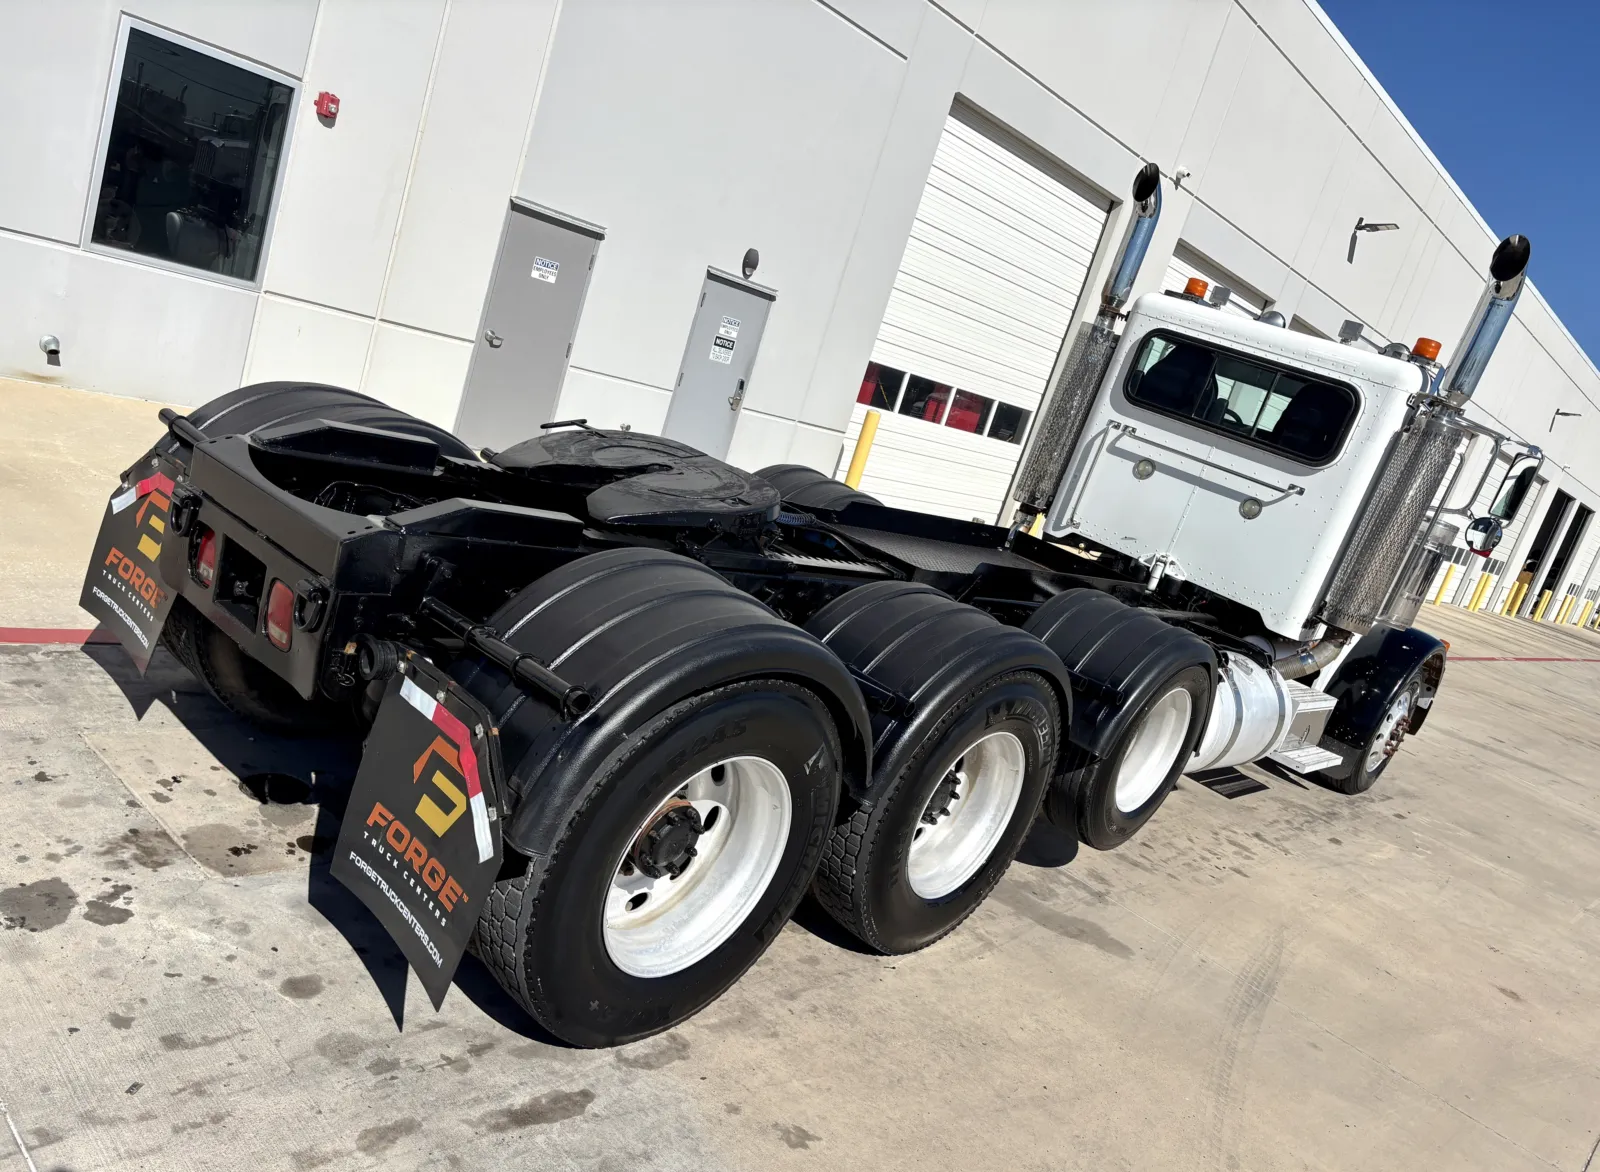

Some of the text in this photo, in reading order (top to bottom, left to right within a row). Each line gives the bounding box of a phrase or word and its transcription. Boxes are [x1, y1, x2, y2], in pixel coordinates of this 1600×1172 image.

[535, 258, 559, 271] NOTICE
[715, 337, 734, 349] NOTICE
[721, 317, 740, 327] NOTICE
[102, 569, 154, 622] TRUCK CENTERS
[105, 547, 166, 609] FORGE
[92, 586, 150, 650] FORGETRUCKCENTERS.COM
[364, 831, 447, 927] TRUCK CENTERS
[366, 801, 464, 913] FORGE
[349, 850, 443, 969] FORGETRUCKCENTERS.COM
